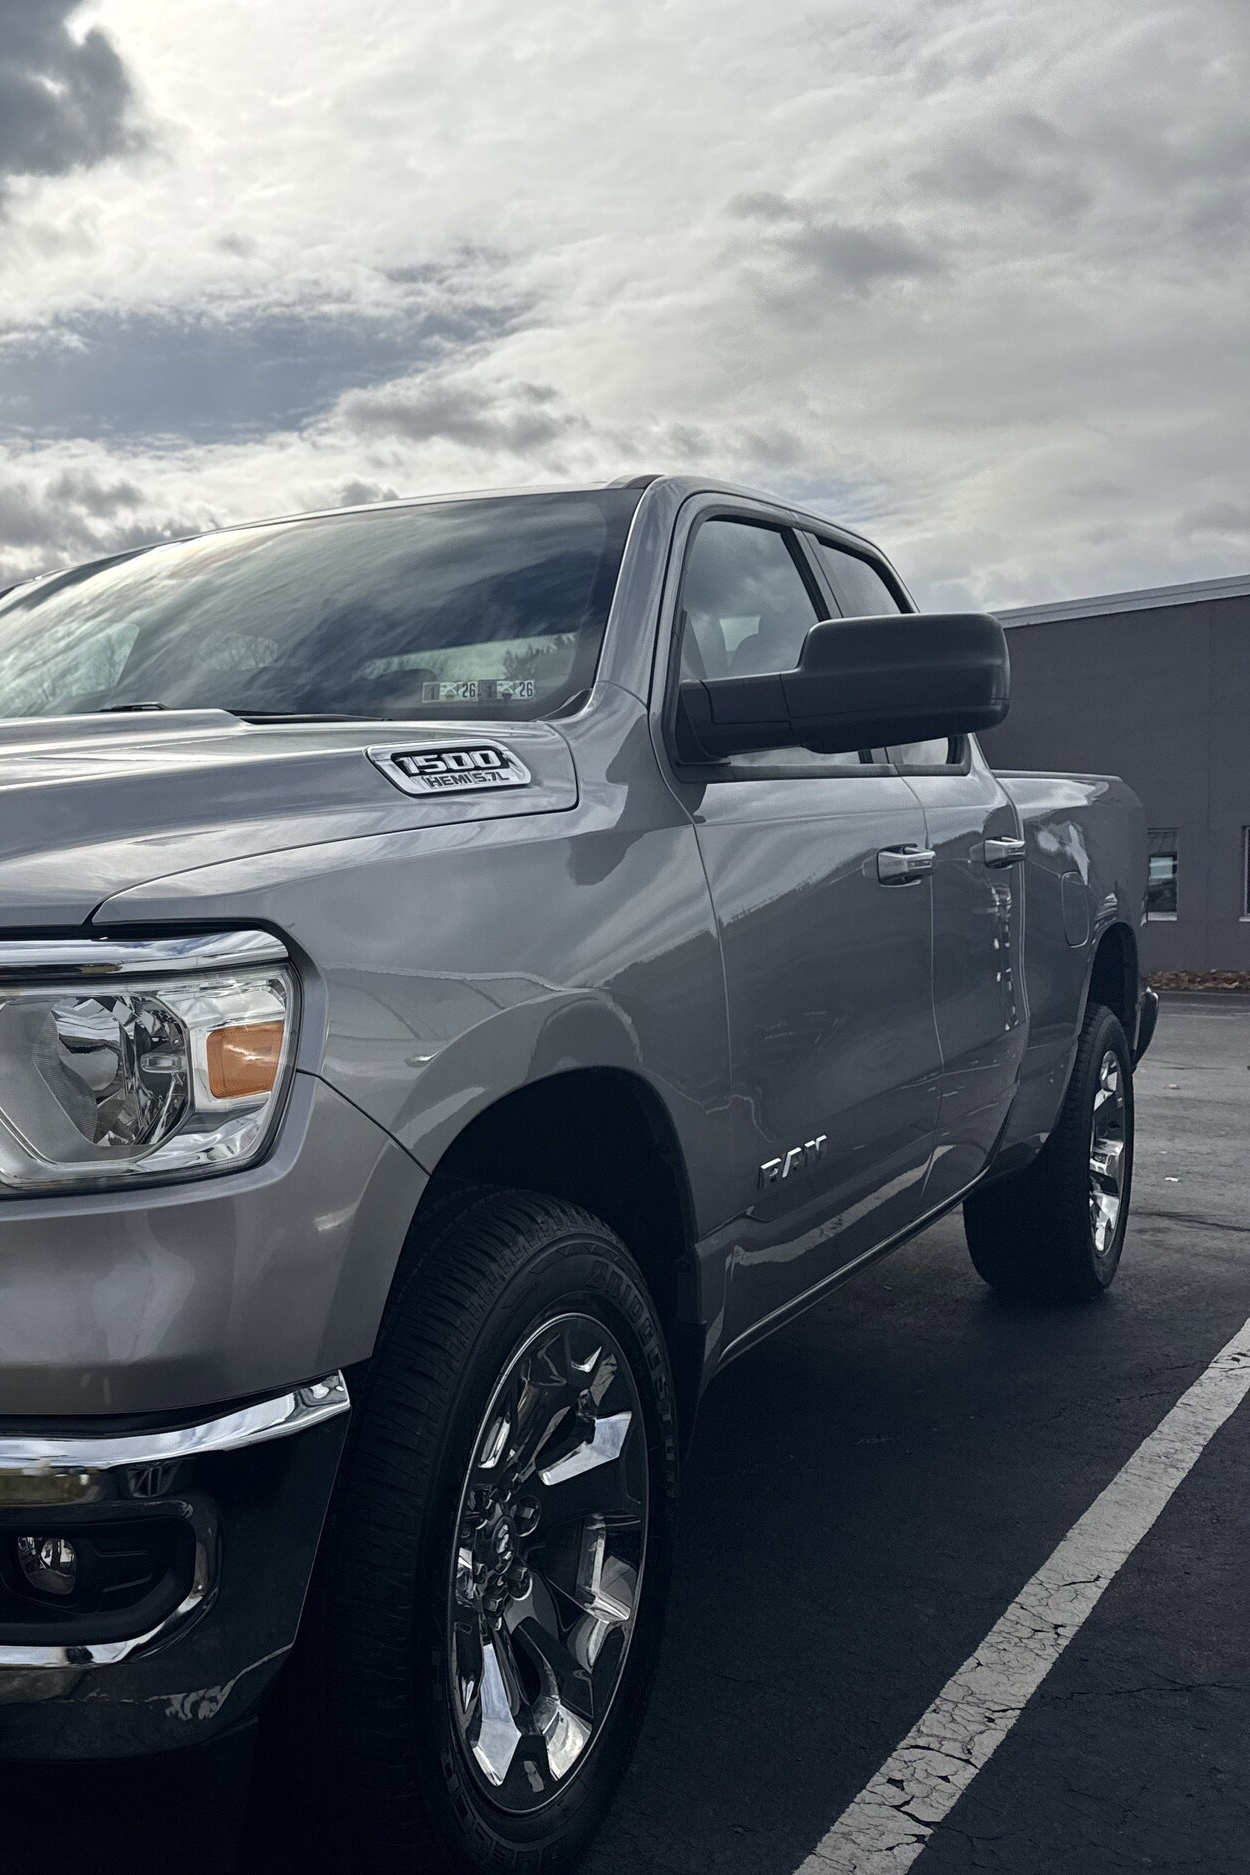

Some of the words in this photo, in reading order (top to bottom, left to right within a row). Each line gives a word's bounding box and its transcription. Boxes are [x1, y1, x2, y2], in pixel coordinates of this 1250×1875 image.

[462, 683, 477, 698] 26
[519, 681, 533, 698] 26
[395, 750, 502, 774] 1500
[423, 773, 473, 788] HEMI
[472, 771, 510, 784] 5.7L
[586, 1259, 679, 1505] BRIDGESTON
